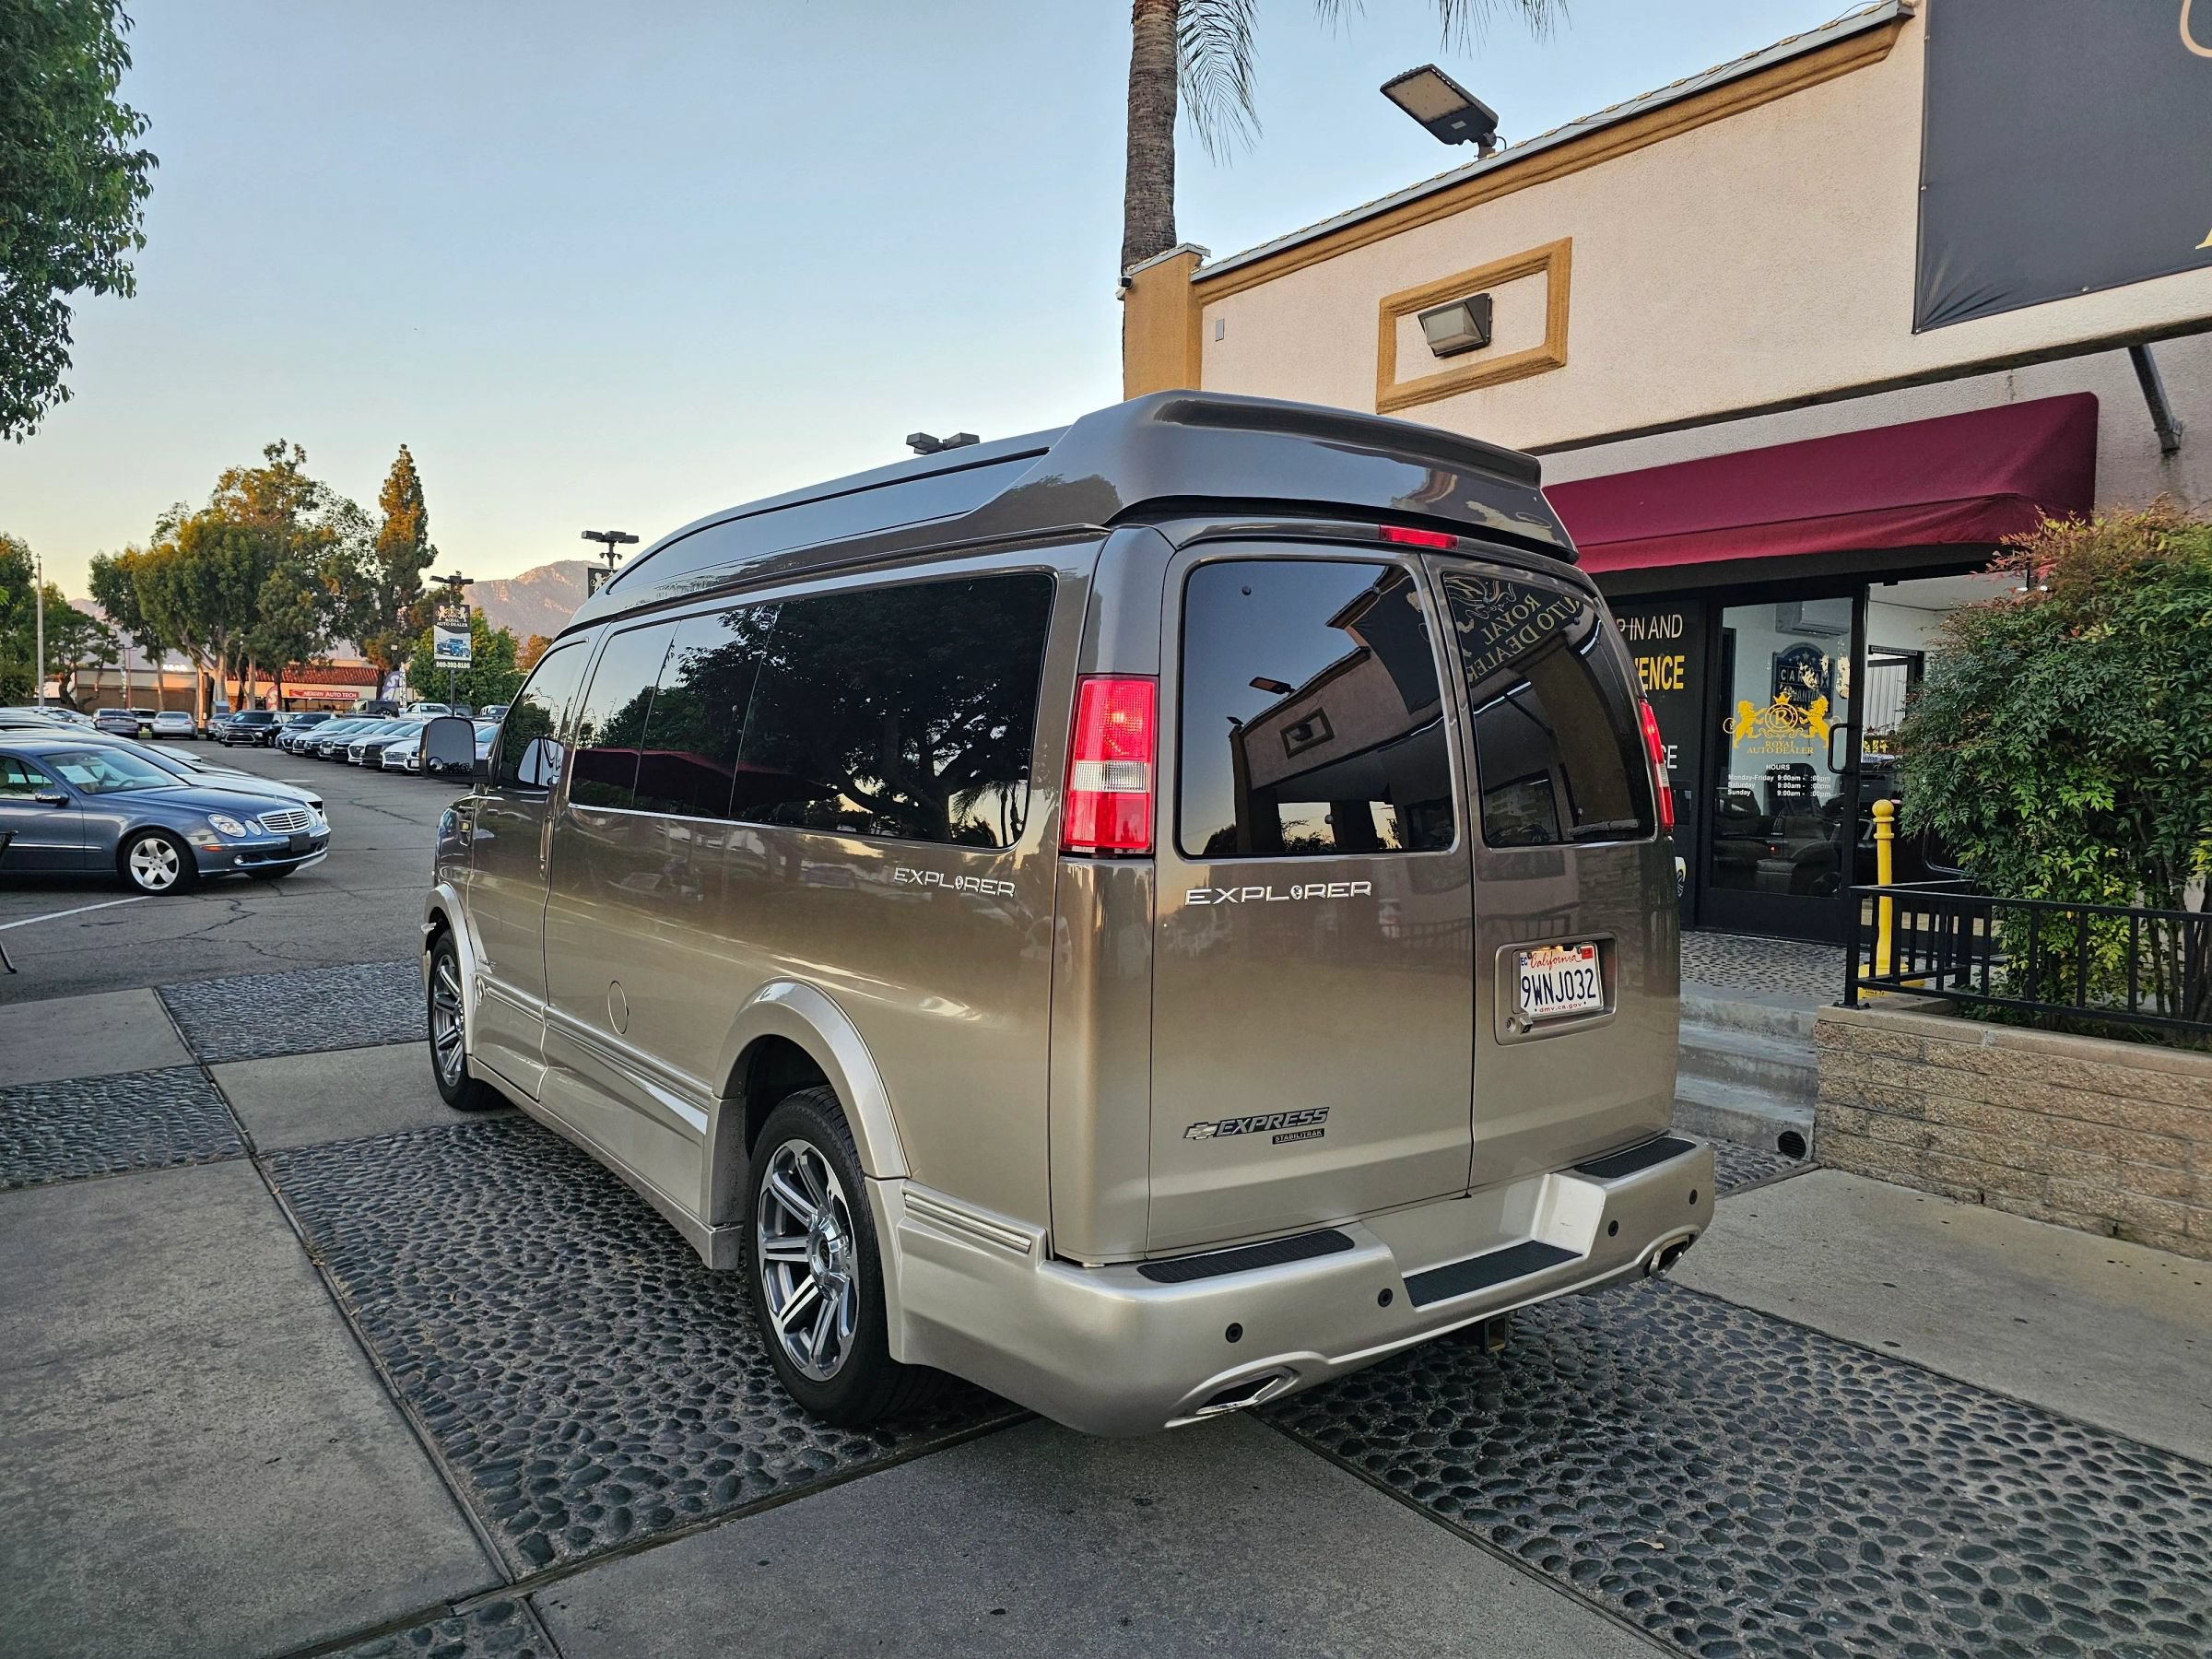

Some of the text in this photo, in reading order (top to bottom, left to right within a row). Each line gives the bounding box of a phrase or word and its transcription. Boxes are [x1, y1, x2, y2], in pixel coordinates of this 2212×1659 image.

[1630, 617, 1645, 641] IN
[1648, 614, 1683, 640] AND
[1781, 669, 1830, 688] CARAX
[1747, 747, 1815, 755] AUTO DEALER
[1765, 740, 1795, 748] ROYAL
[1728, 773, 1774, 782] Monday-Friday
[1728, 782, 1756, 790] Saturday
[1728, 789, 1751, 797] Sunday
[893, 867, 1016, 898] EXPLORER
[1184, 880, 1371, 906] EXPLORER
[1530, 950, 1583, 971] California
[1522, 968, 1596, 1007] 9WNJ032
[1539, 1002, 1583, 1013] dmv.ca.gov
[1216, 1108, 1330, 1137] EXPRESS
[1275, 1130, 1324, 1144] STABILITRAK
